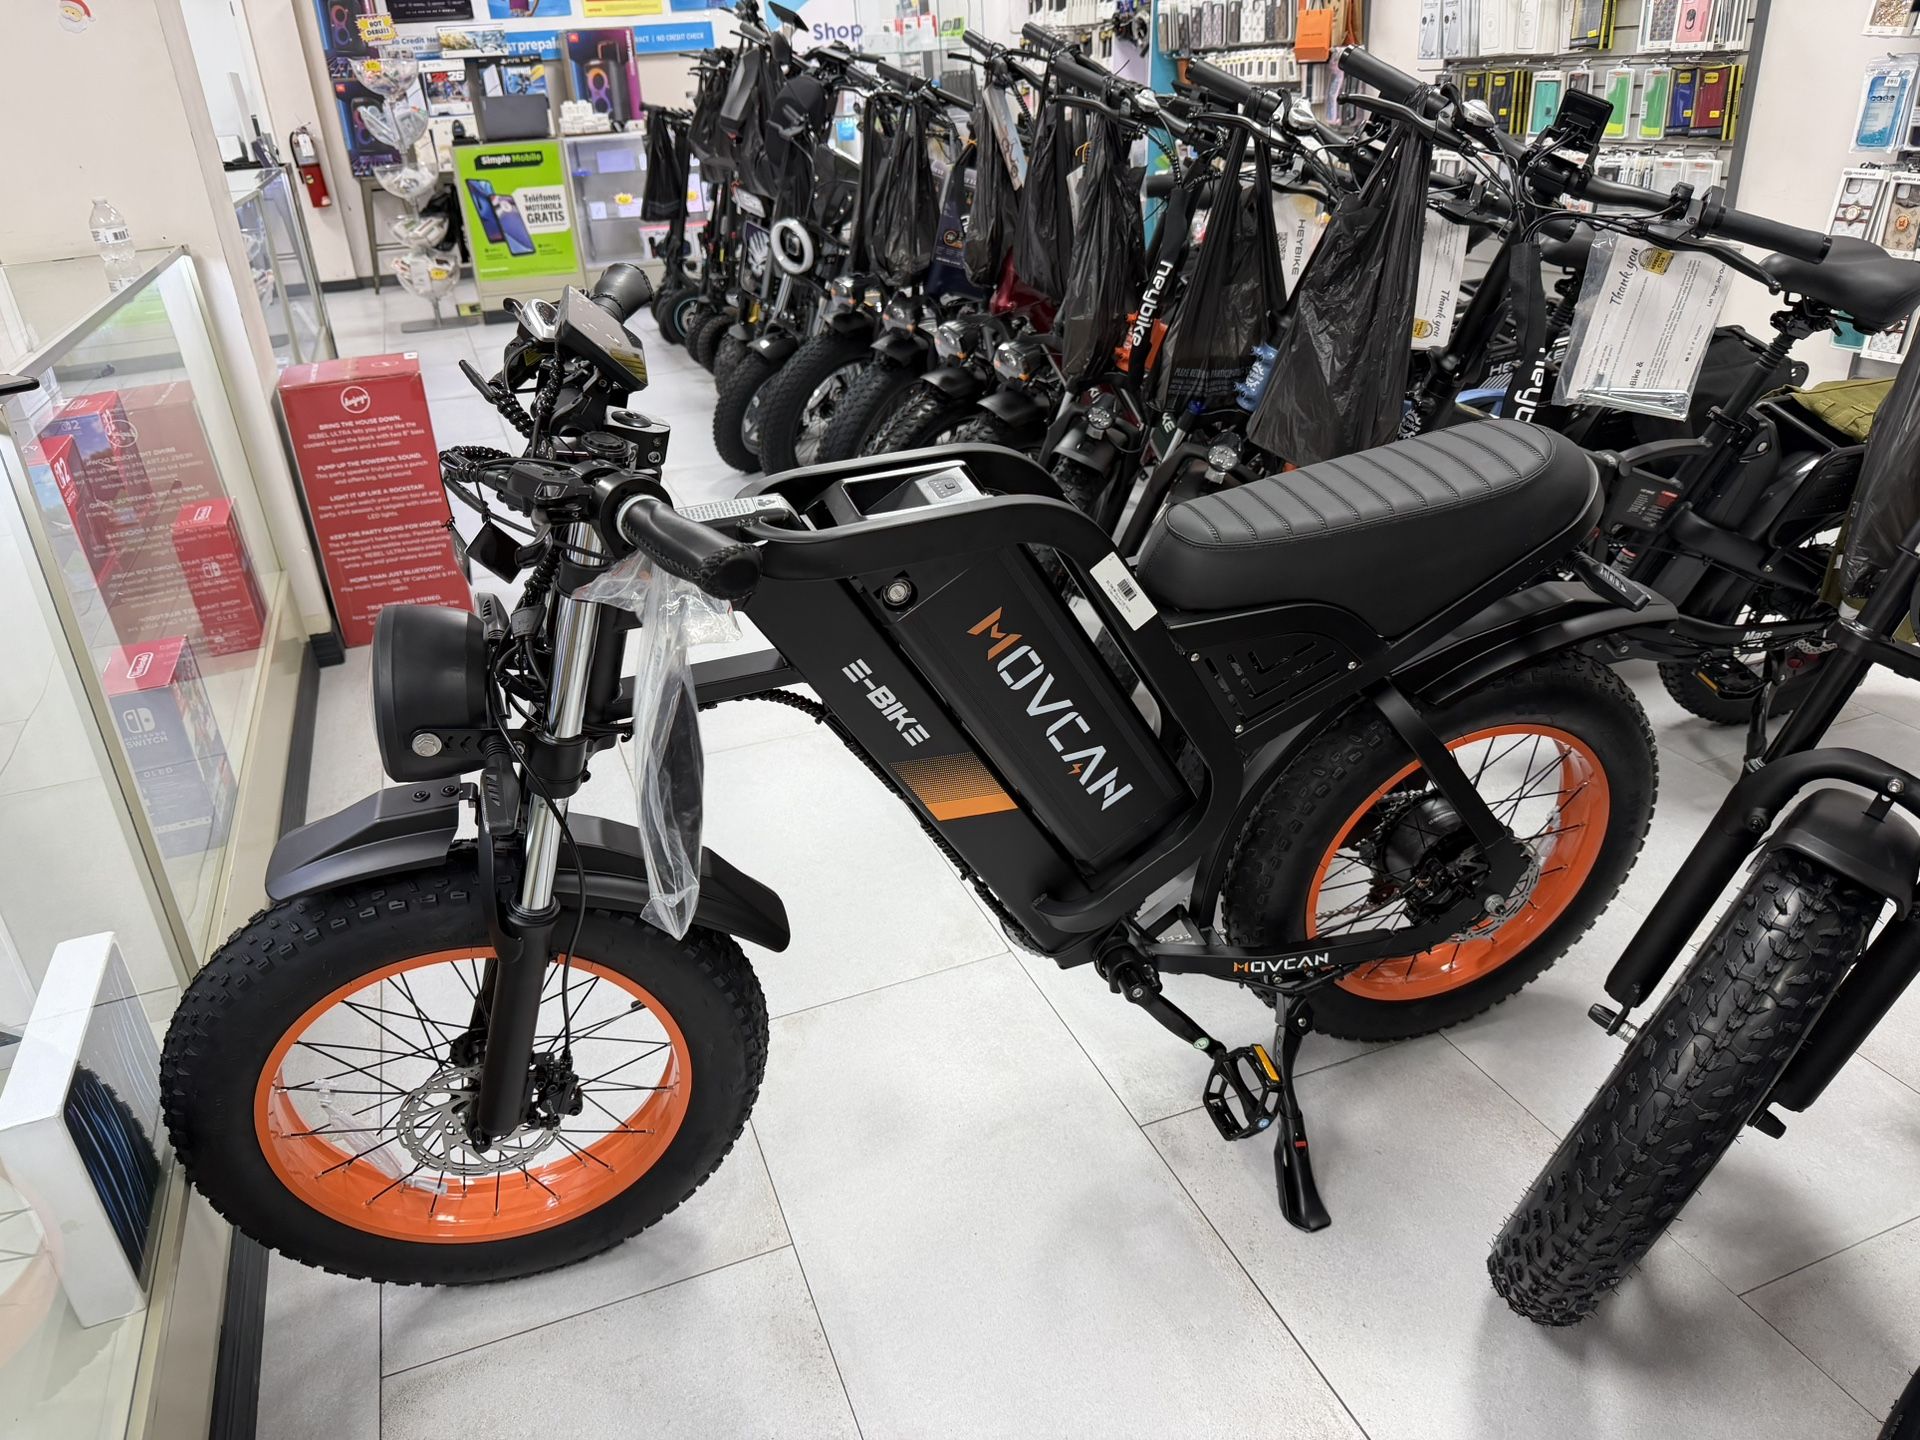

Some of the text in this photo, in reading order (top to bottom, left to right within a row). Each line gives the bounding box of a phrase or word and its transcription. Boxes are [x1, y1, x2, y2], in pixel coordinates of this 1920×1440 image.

[813, 22, 862, 43] Shop
[517, 36, 556, 54] prepai
[481, 152, 542, 165] Simple Mobile
[525, 204, 563, 212] MOTOROLA
[527, 212, 565, 224] GRATIS
[1292, 219, 1306, 276] HEYBIKE
[1609, 270, 1633, 306] Thank
[1627, 247, 1640, 272] you
[1132, 260, 1174, 346] heybike
[1432, 290, 1450, 338] Thank you
[360, 456, 396, 465] POWERFUL
[389, 483, 424, 493] ROCKSTAR!
[416, 594, 441, 602] STEREO.
[1742, 630, 1773, 641] Mars
[841, 658, 930, 748] E-BIKE
[967, 606, 1134, 812] MOVCAN
[126, 735, 168, 748] SWITCH
[144, 767, 174, 778] OLED
[1233, 952, 1329, 973] MOVCAN
